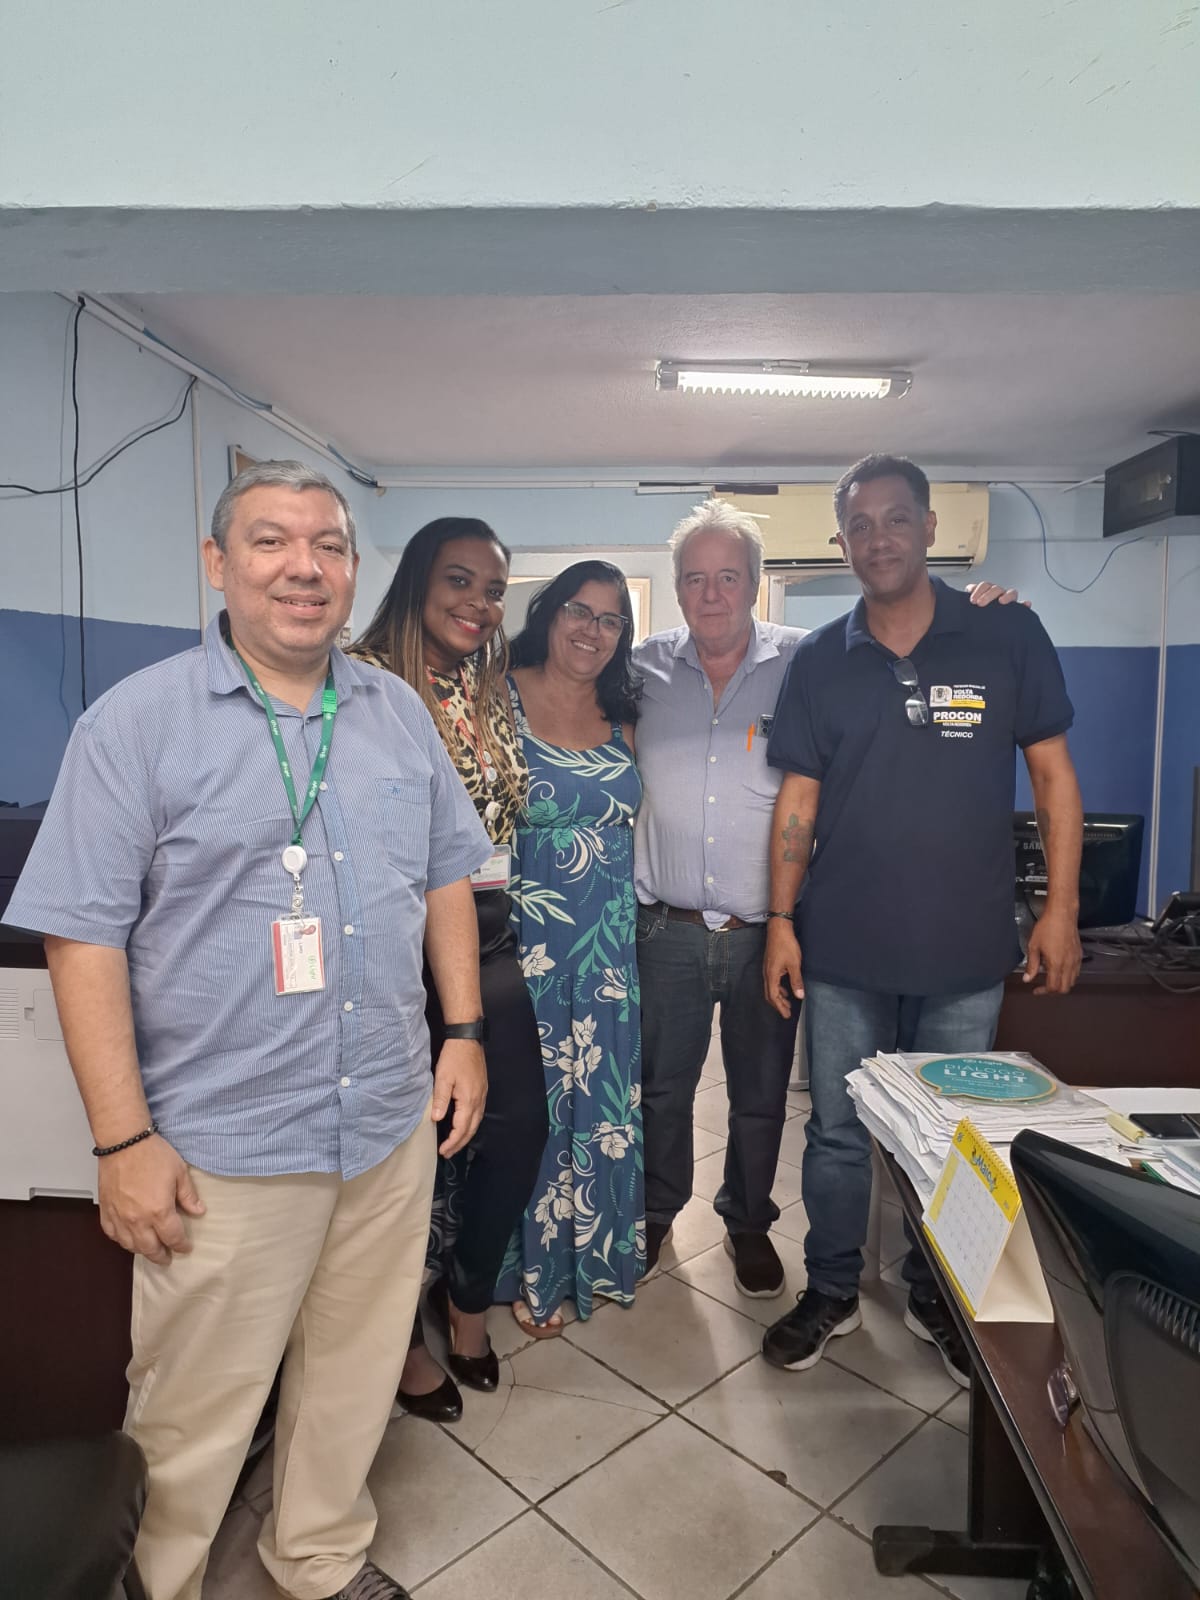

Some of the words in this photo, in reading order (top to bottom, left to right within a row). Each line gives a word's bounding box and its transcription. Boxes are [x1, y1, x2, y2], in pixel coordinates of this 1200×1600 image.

[933, 711, 982, 722] PROCON
[941, 730, 973, 739] TÉCNICO
[944, 1068, 1028, 1083] LIGHT
